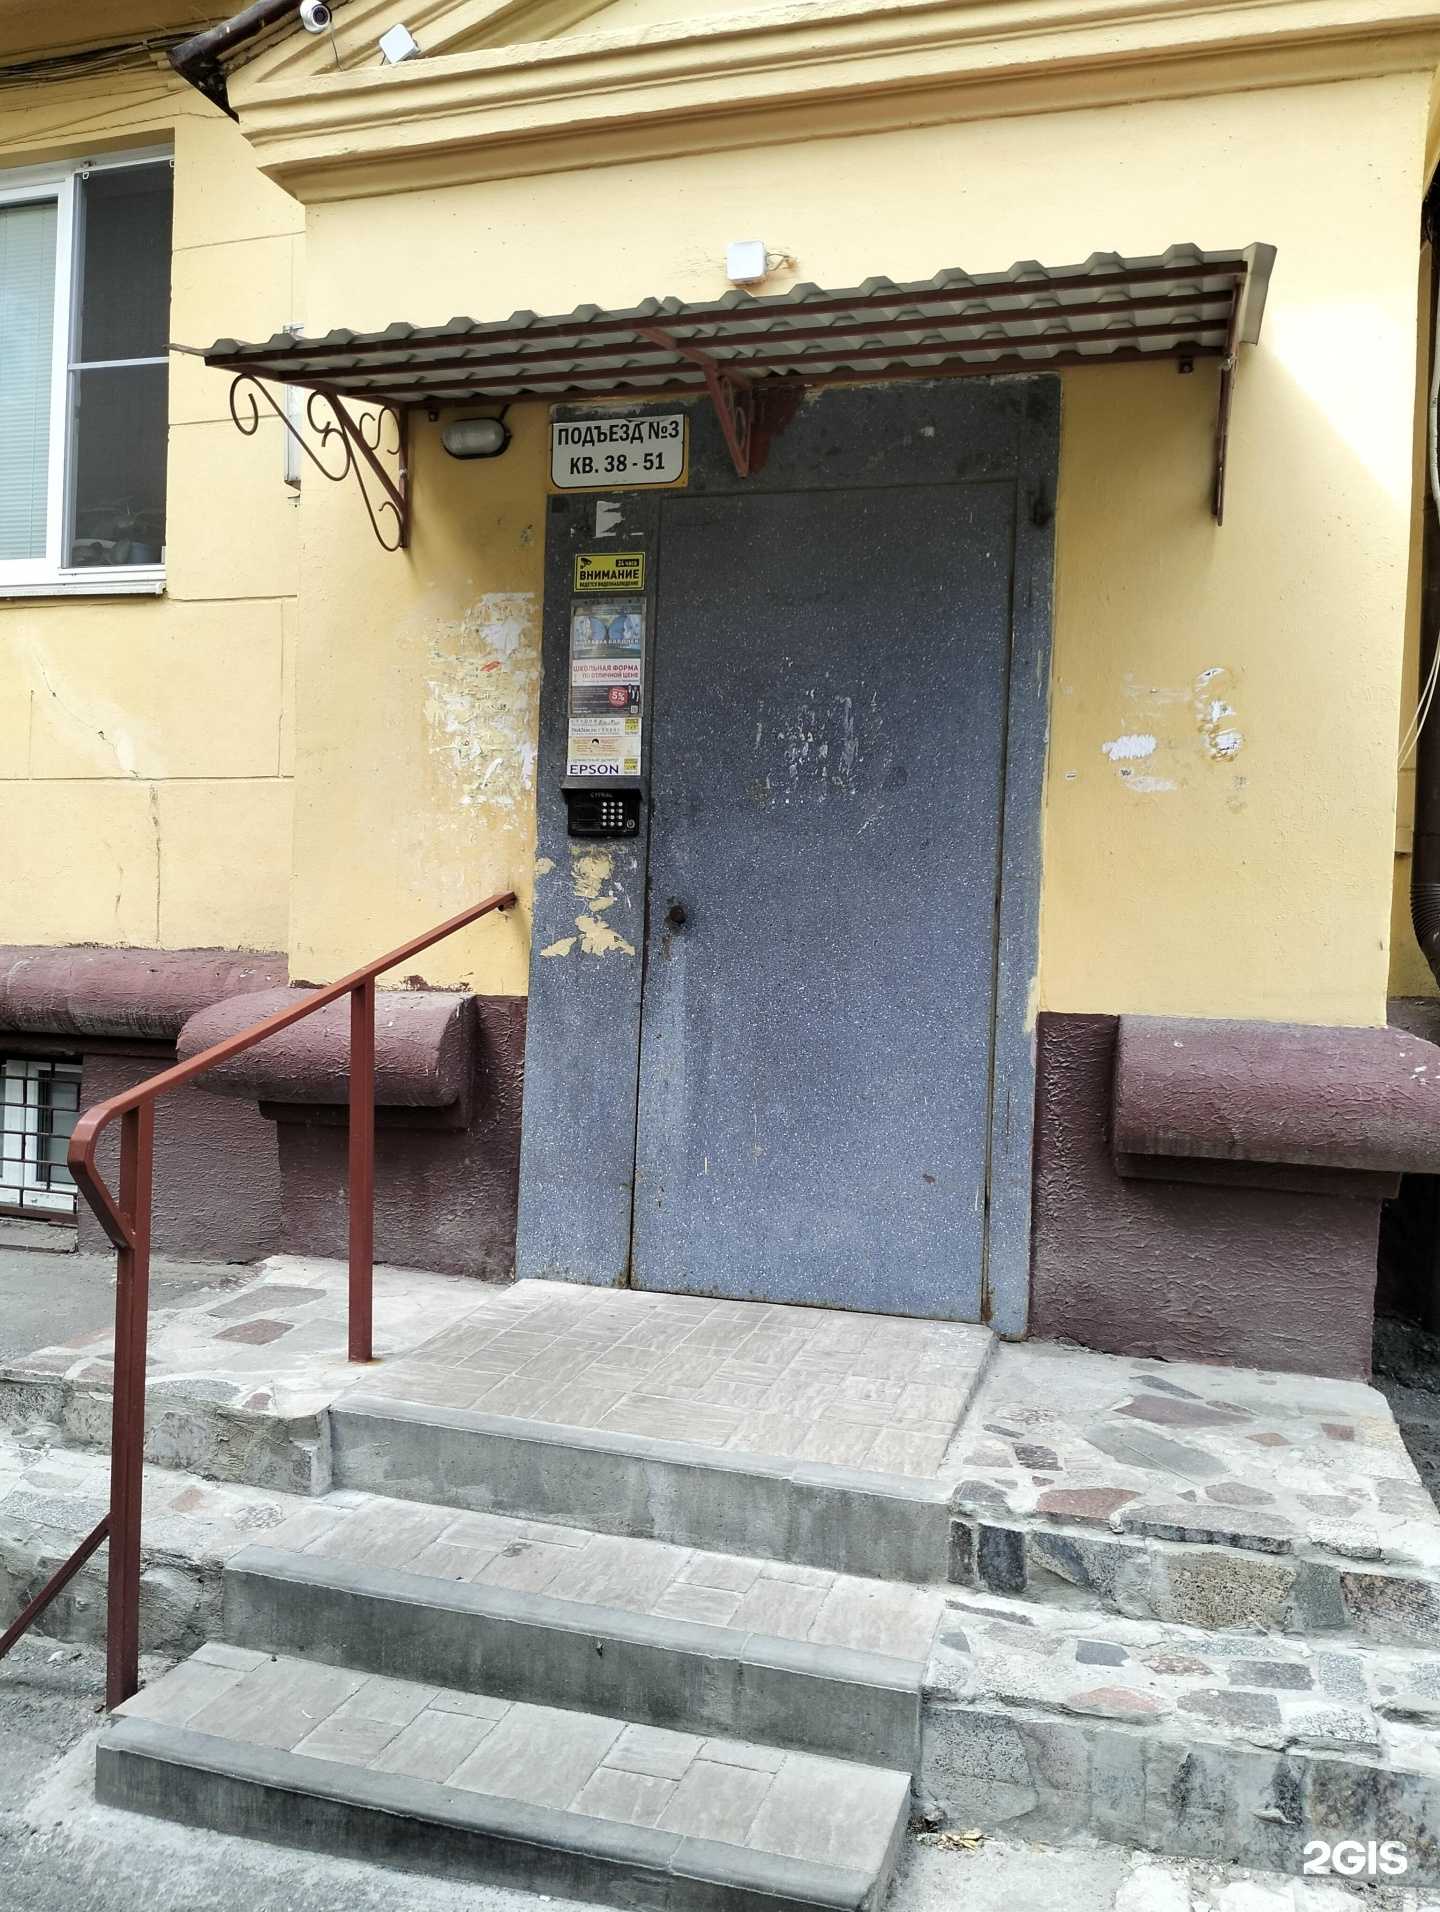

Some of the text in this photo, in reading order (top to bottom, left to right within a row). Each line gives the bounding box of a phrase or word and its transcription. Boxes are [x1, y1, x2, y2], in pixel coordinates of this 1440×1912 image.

[558, 420, 680, 447] ПОДЪЕЗД №3
[570, 456, 599, 475] КВ.
[604, 454, 627, 473] 38
[643, 452, 665, 470] 51
[579, 569, 639, 581] ВНИМАНИЕ
[573, 664, 611, 672] ШКОЛЬНАЯ
[611, 691, 625, 702] 5%
[570, 764, 619, 775] EPSON
